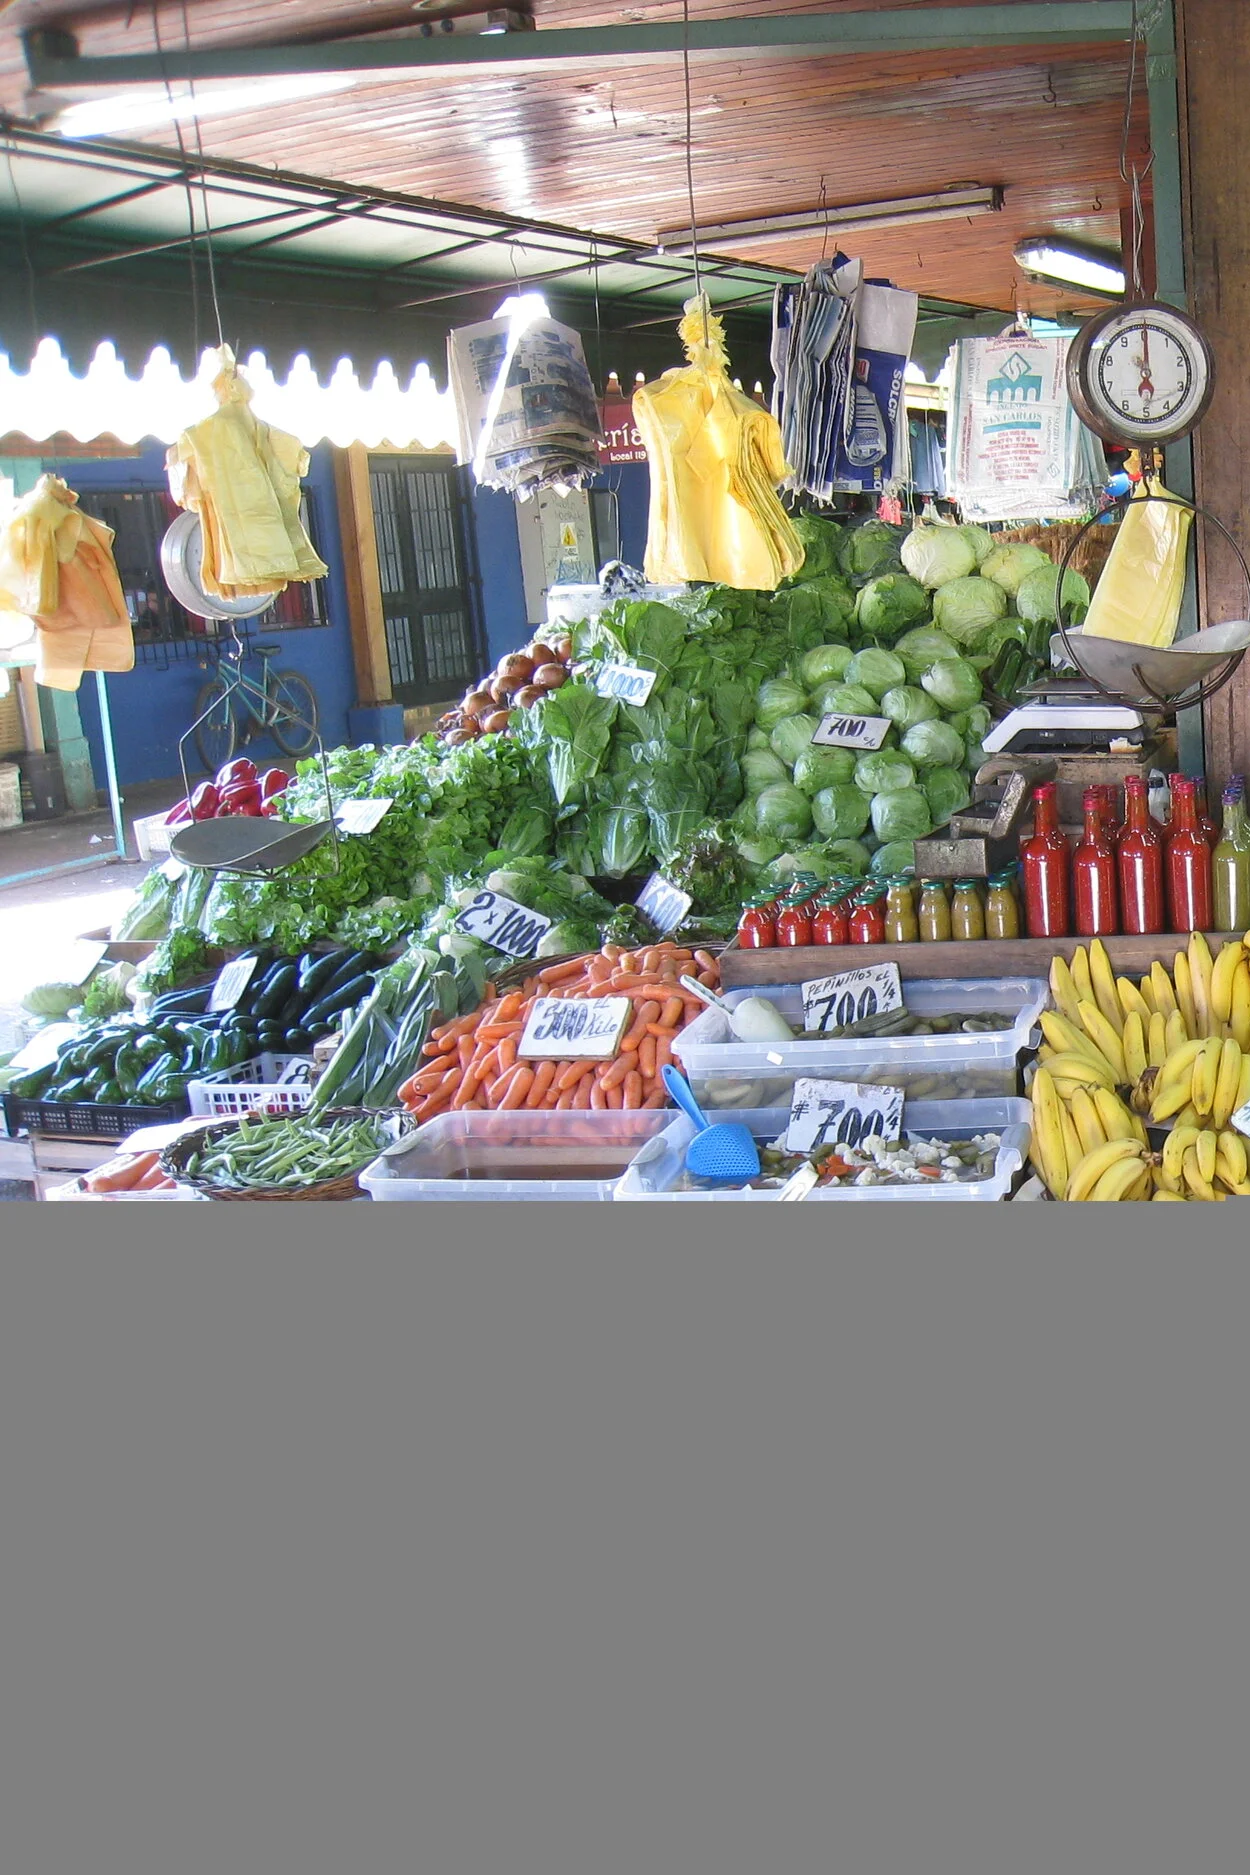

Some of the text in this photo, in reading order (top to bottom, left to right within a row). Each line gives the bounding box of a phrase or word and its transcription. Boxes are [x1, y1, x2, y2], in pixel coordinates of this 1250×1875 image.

[1121, 336, 1128, 348] 9
[1164, 337, 1169, 348] 1
[1106, 356, 1113, 366] 8
[1177, 356, 1184, 367] 2
[1106, 381, 1113, 392] 7
[1177, 382, 1184, 392] 3
[1122, 400, 1129, 411] 6
[1162, 400, 1170, 411] 4
[1143, 407, 1150, 418] 5
